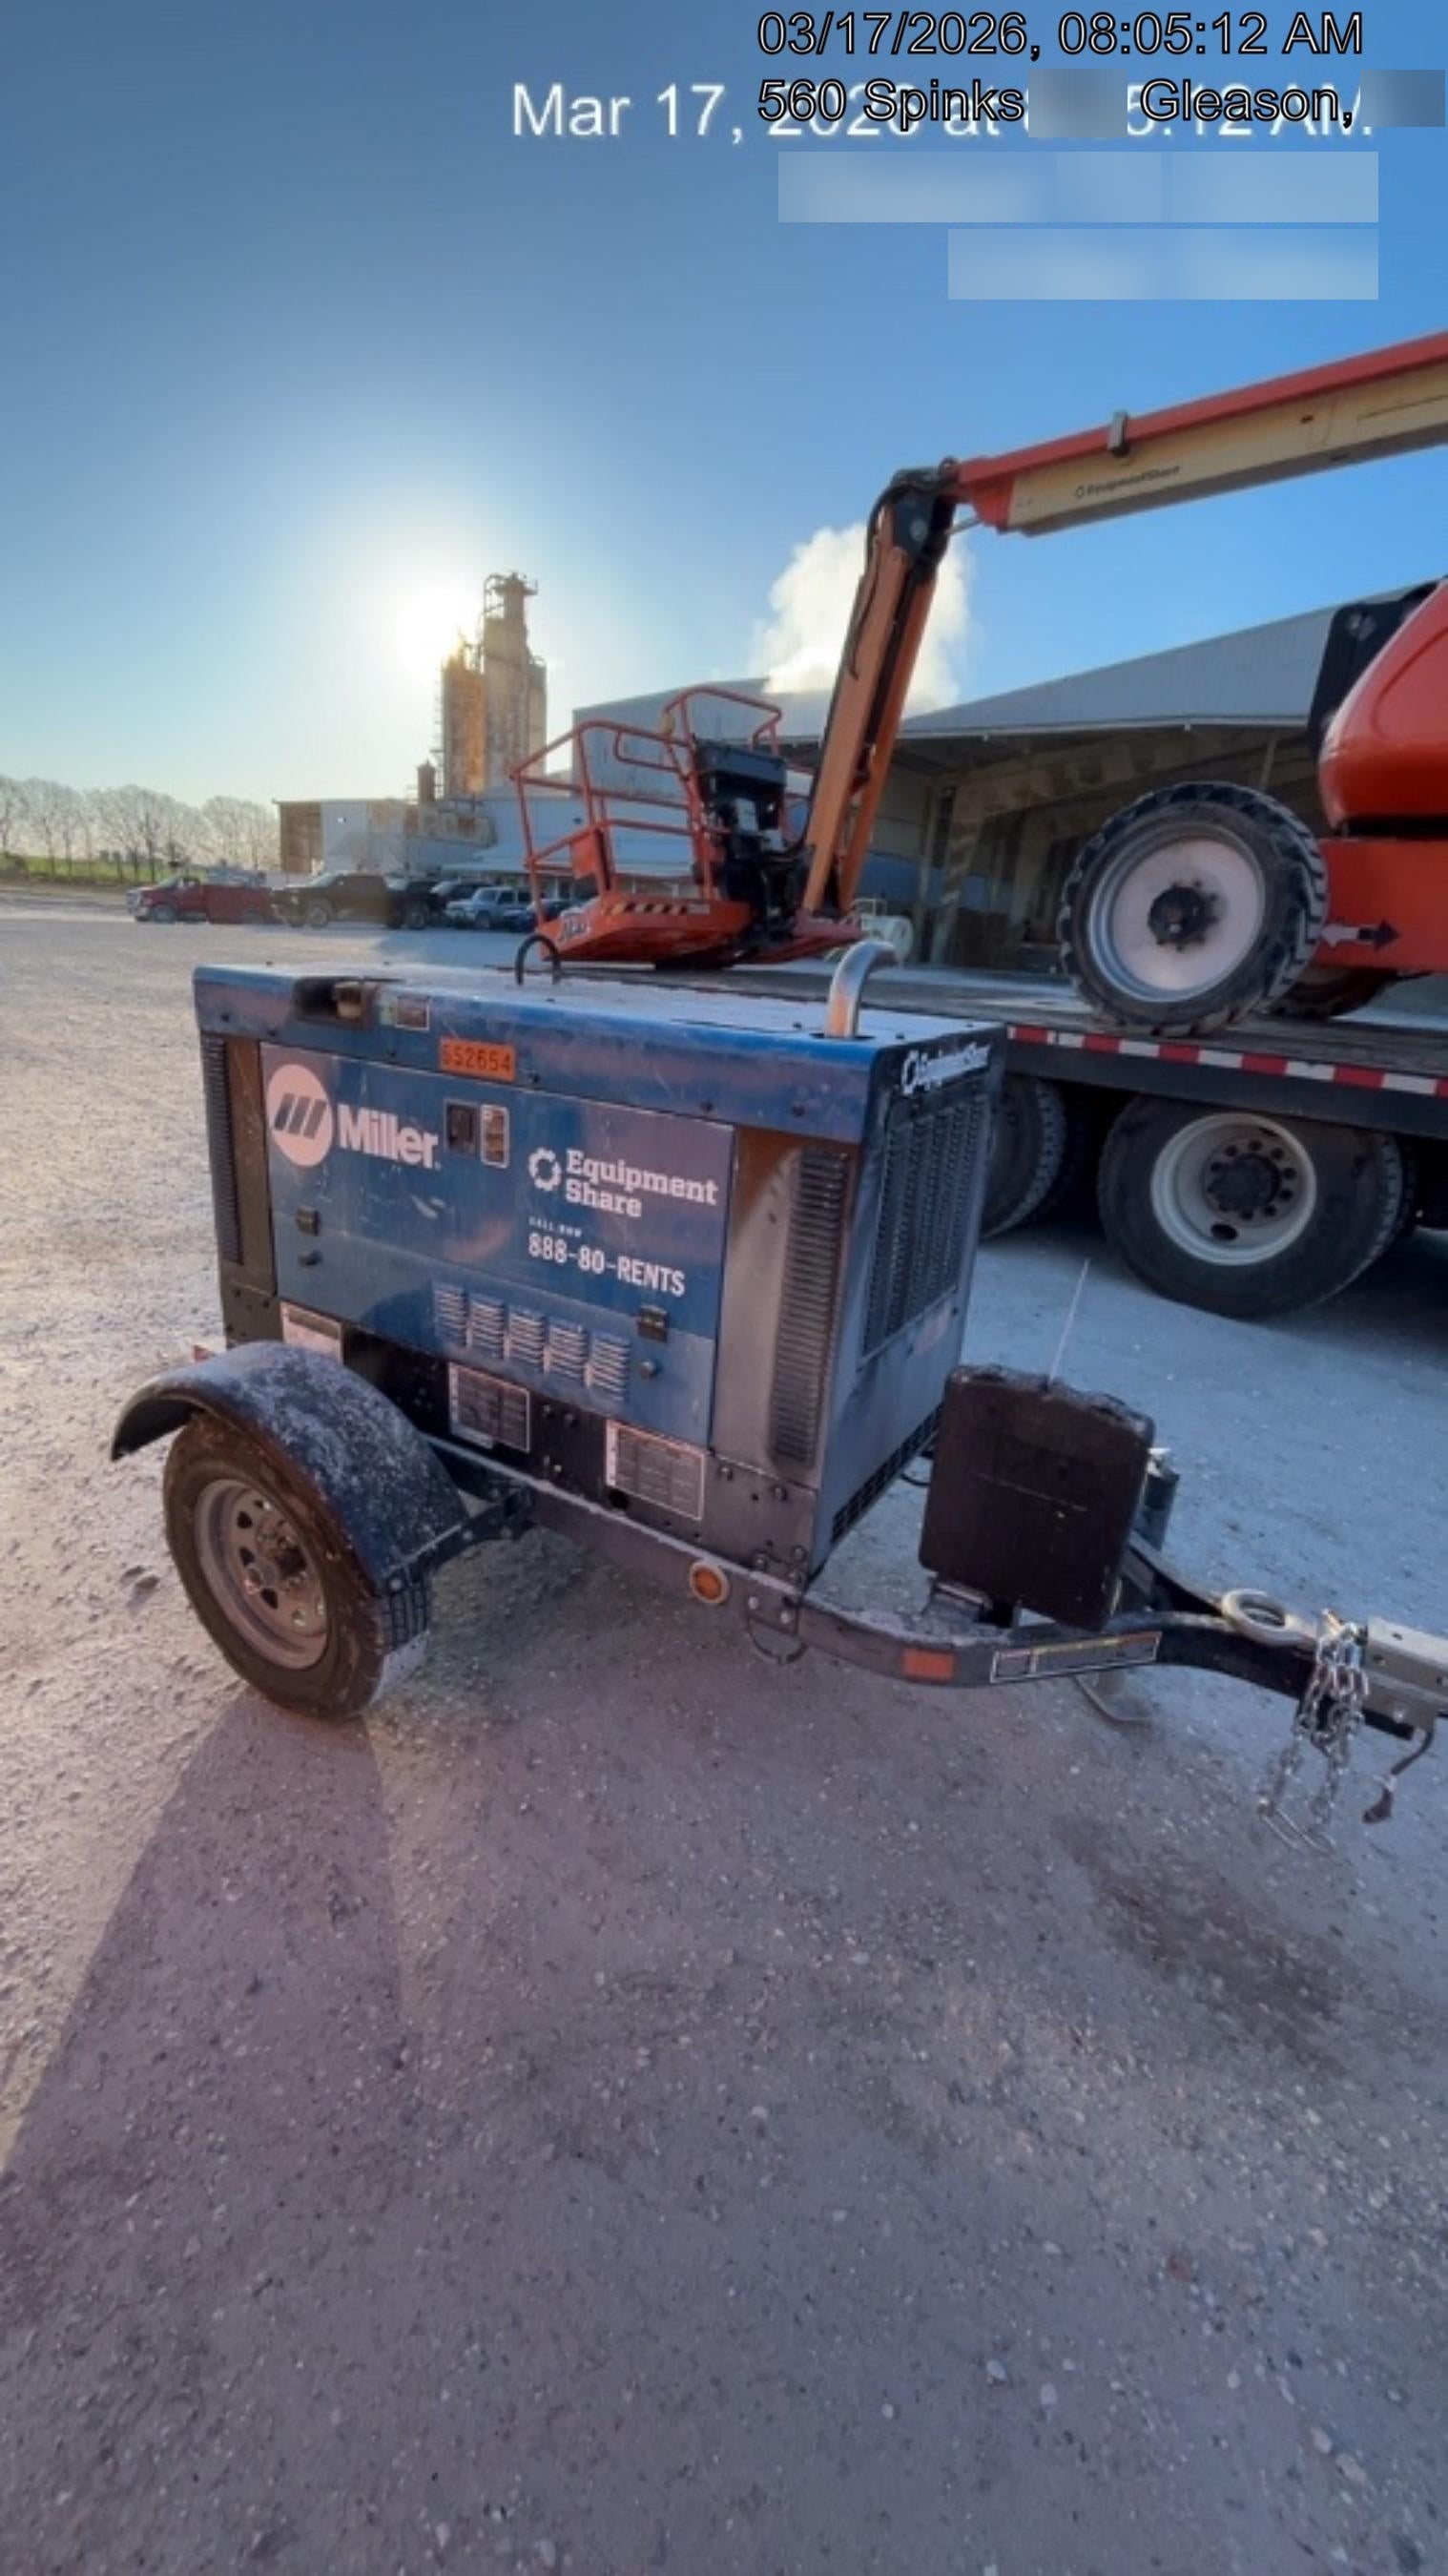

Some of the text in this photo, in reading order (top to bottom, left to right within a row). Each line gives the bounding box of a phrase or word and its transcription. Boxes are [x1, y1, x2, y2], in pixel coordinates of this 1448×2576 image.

[337, 1103, 438, 1169] Miller
[566, 1149, 718, 1206] Equipment
[566, 1178, 643, 1217] Share
[528, 1232, 685, 1298] 888-80-RENTS
